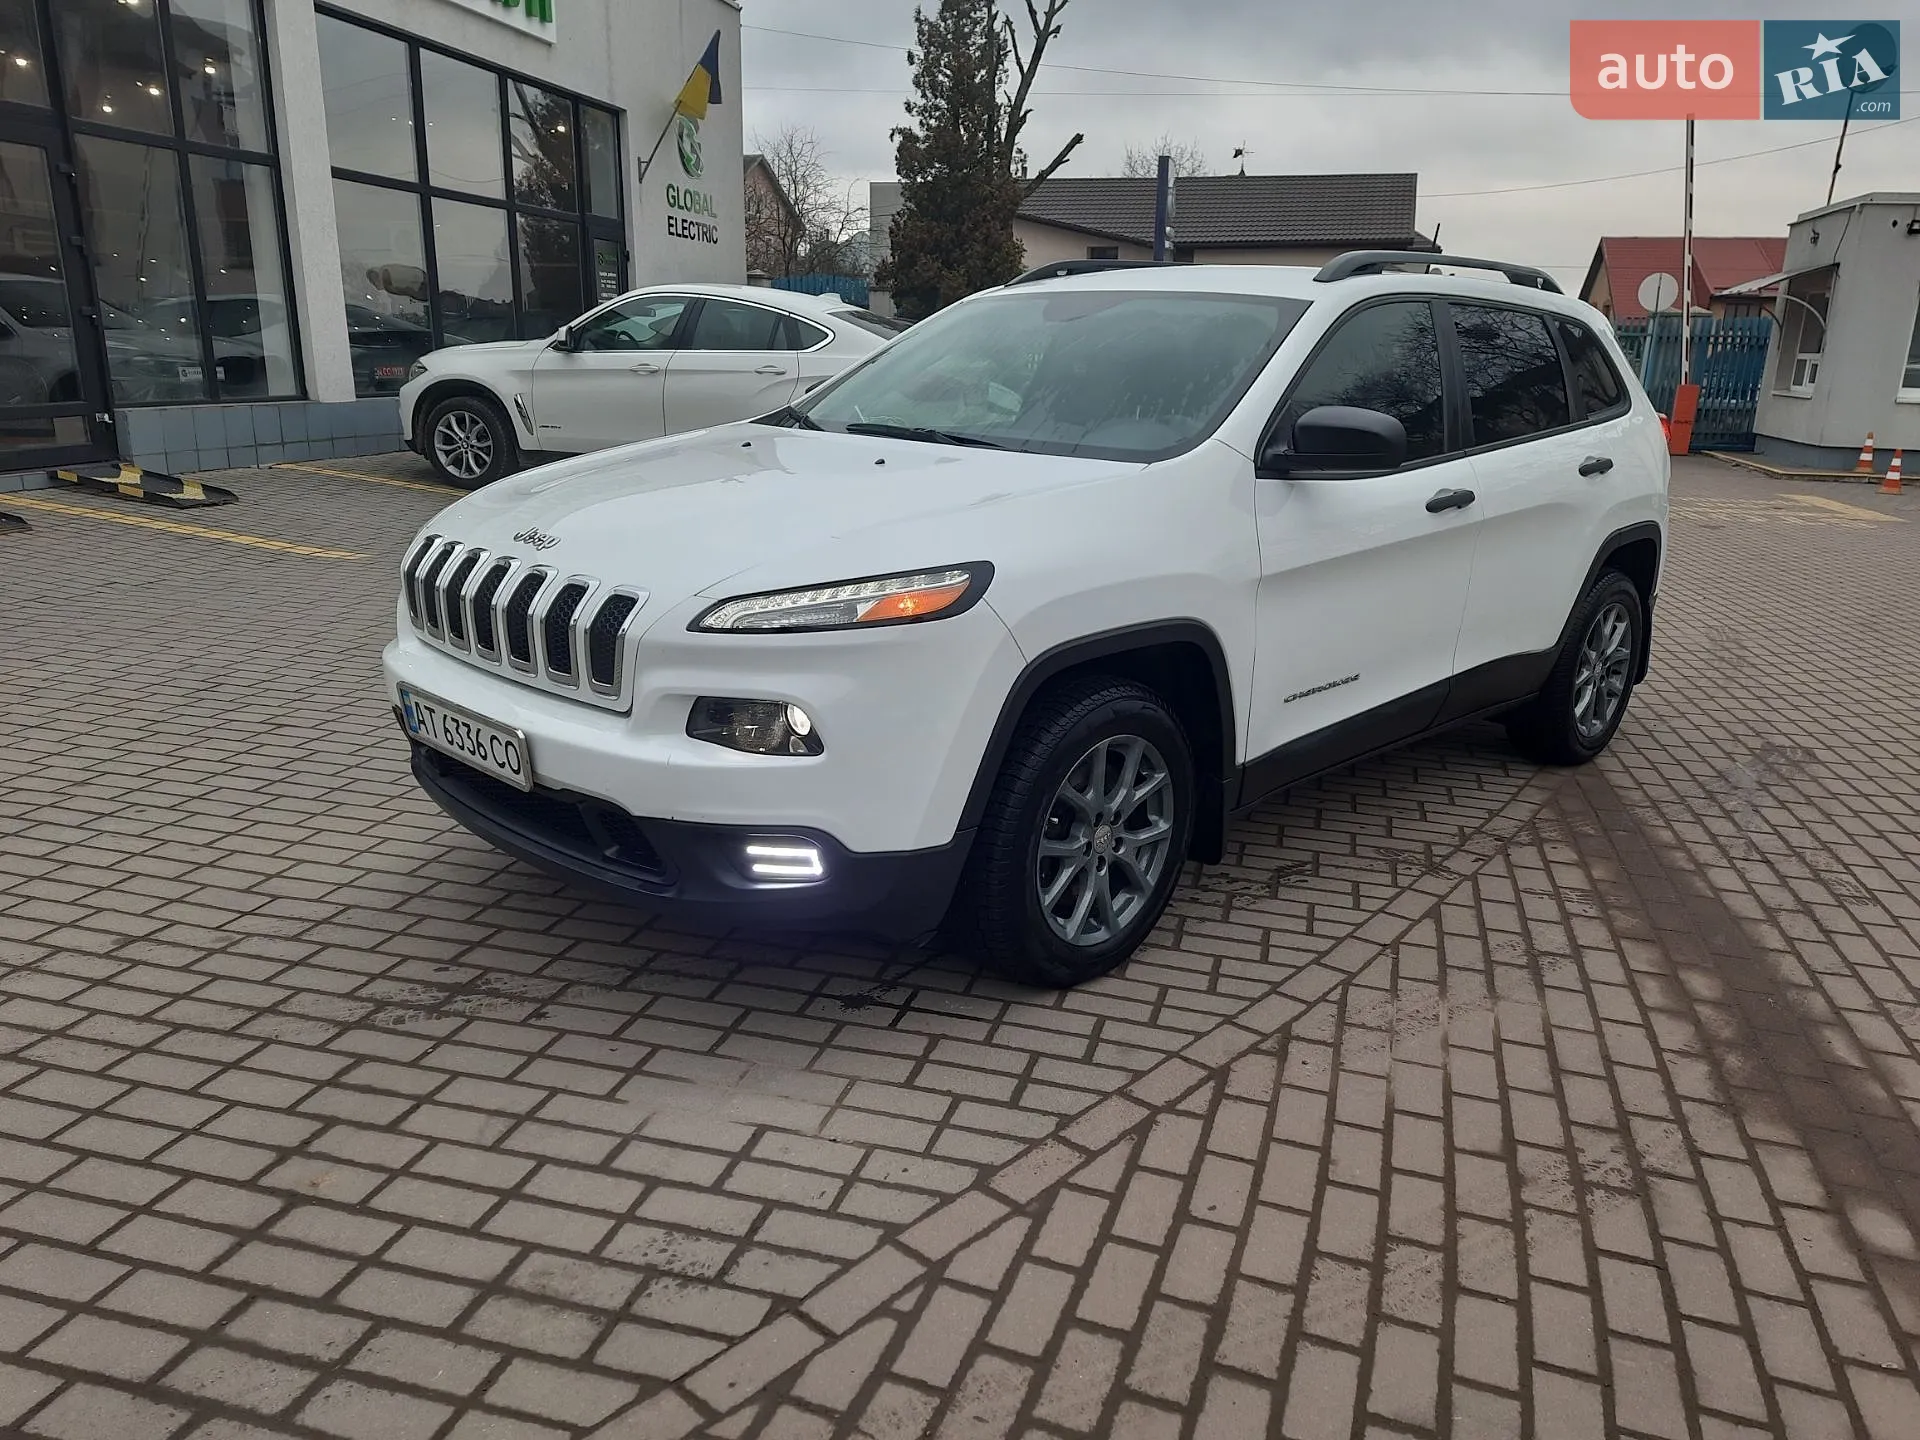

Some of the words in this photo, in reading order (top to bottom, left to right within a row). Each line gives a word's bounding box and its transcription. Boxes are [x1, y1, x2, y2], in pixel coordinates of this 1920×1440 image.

[666, 183, 718, 219] GLOBAL
[667, 215, 719, 245] ELECTRIC
[513, 526, 561, 551] Jeep
[1283, 673, 1360, 703] CHEROKEE
[415, 701, 438, 739] AT
[443, 714, 488, 761] 6336
[490, 734, 521, 775] CO
